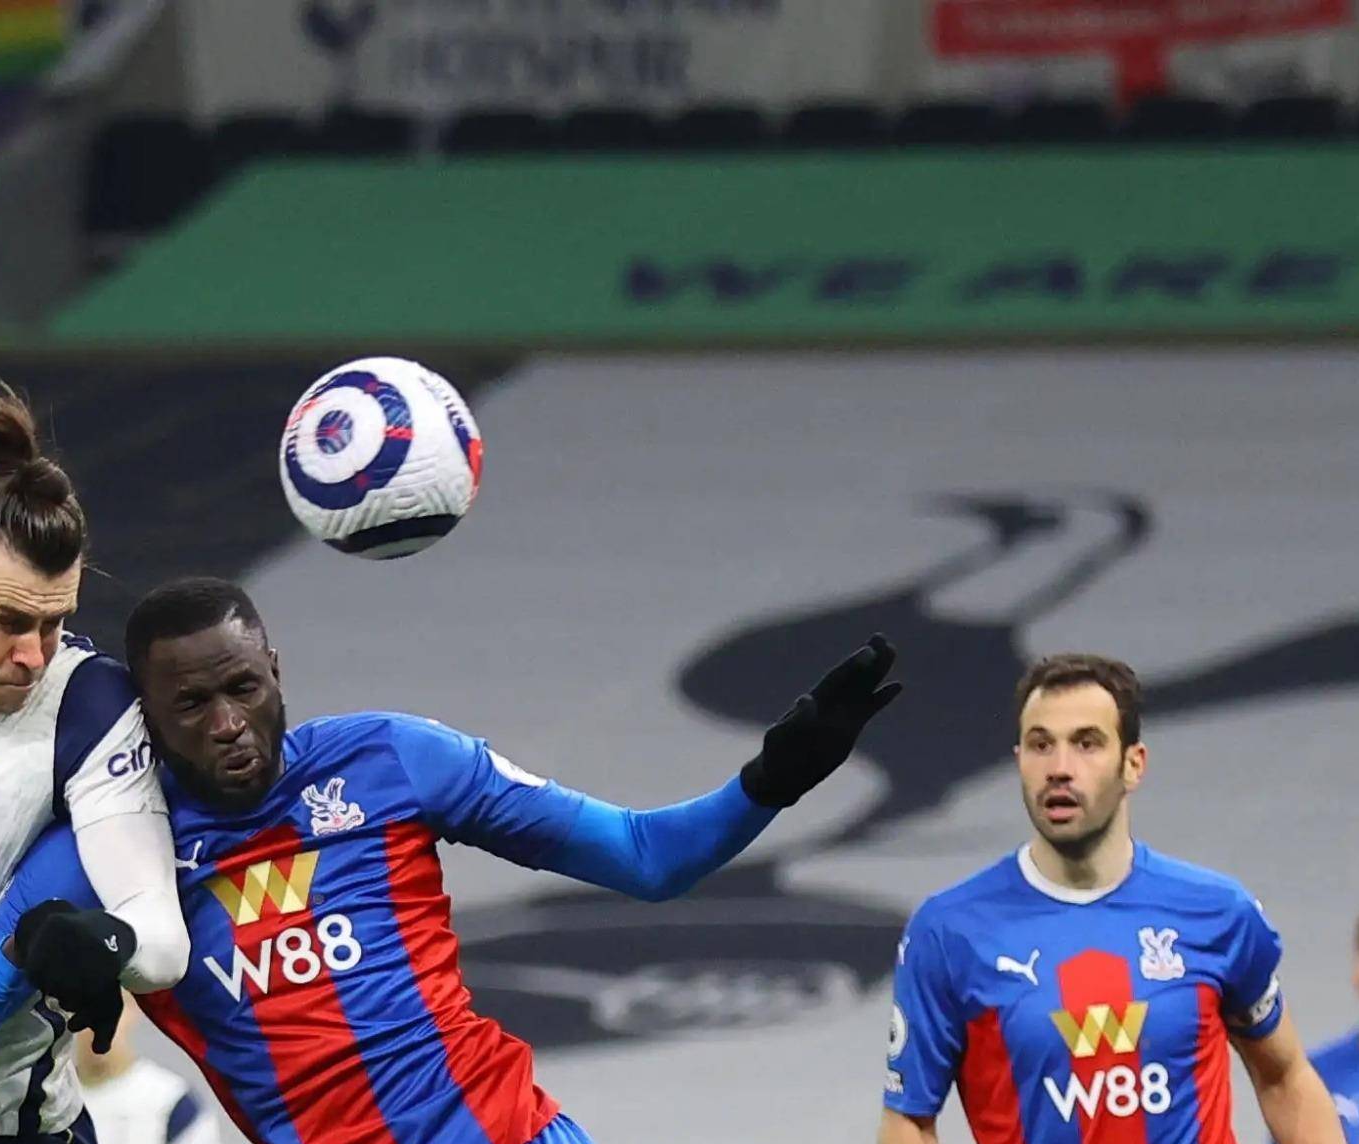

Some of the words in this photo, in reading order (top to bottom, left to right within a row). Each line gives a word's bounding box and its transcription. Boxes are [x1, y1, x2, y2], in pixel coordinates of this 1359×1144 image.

[622, 248, 927, 302] WE
[954, 246, 1354, 302] ARE
[203, 913, 363, 1003] W88
[1043, 1062, 1172, 1123] W88
